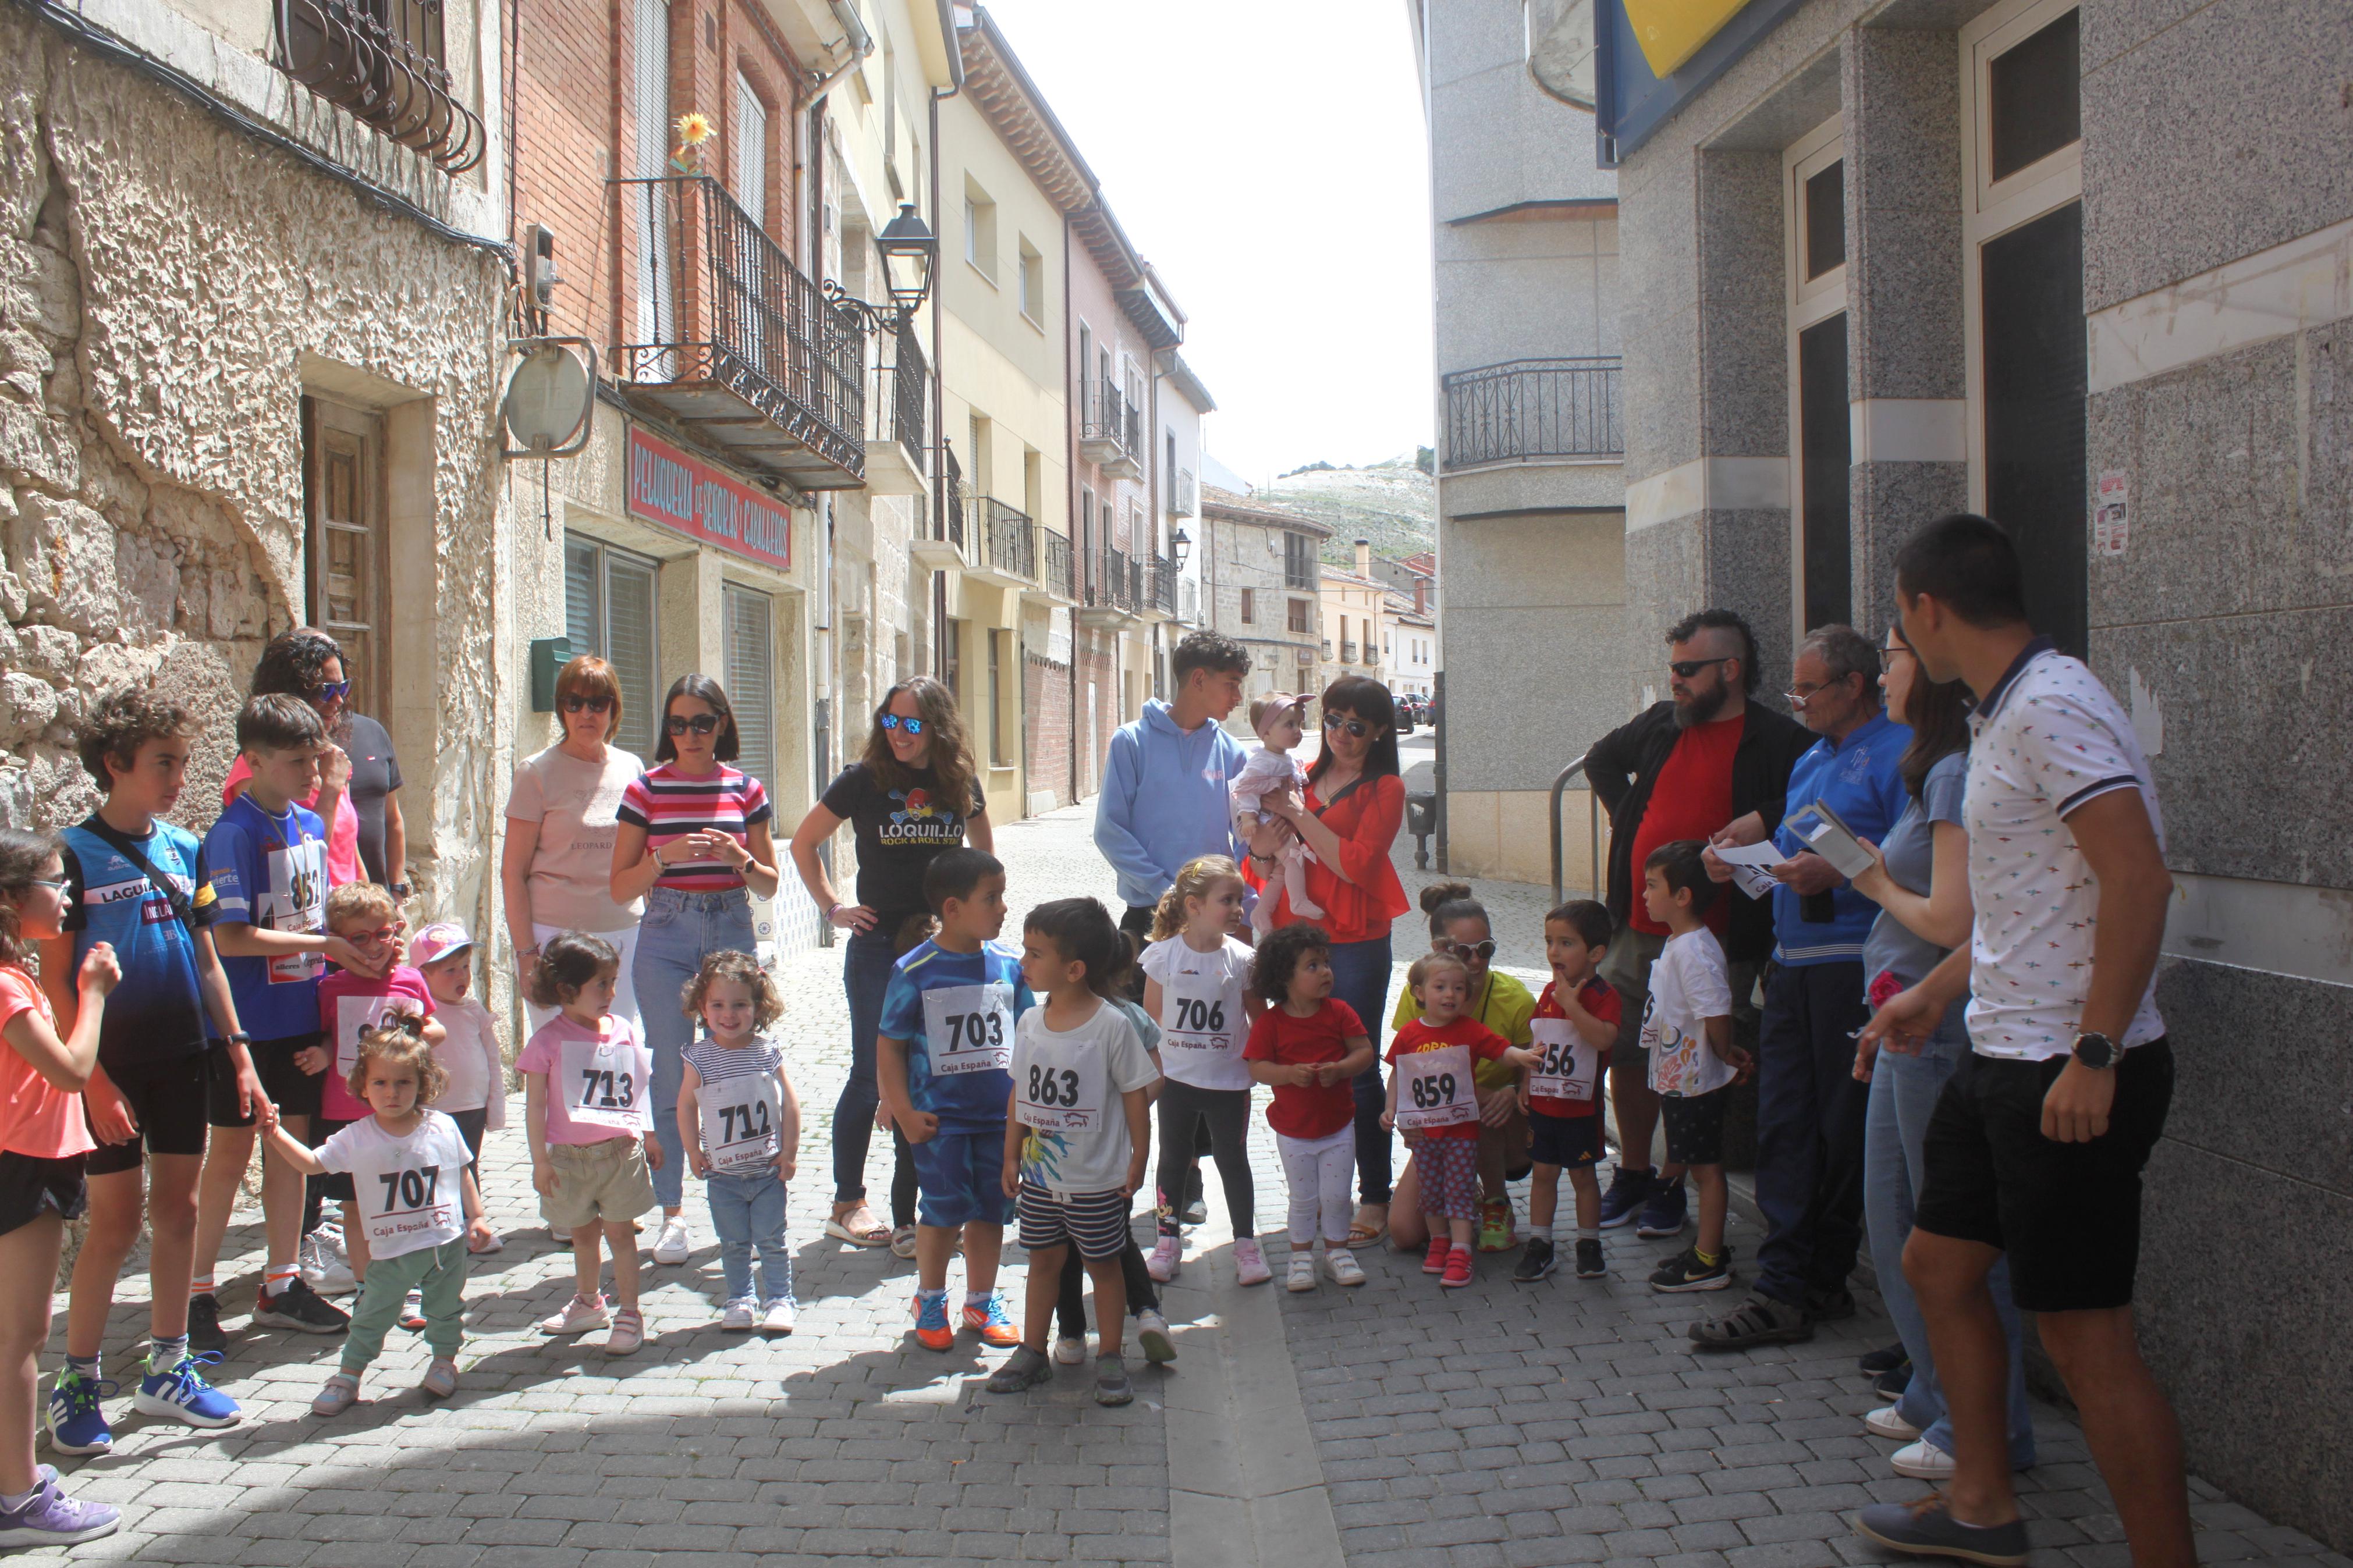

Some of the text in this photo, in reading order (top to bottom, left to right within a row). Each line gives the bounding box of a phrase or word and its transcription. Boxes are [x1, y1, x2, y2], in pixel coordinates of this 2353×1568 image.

[634, 442, 787, 559] PELUQUERIA DE SEÑORAS Y CABALLEROS
[879, 824, 962, 838] LOQUILLO
[571, 842, 612, 850] LEOPARD
[881, 837, 908, 845] ROCK
[1755, 879, 1773, 893] Caja
[1176, 998, 1225, 1032] 706
[945, 1012, 1003, 1052] 703
[1168, 1039, 1206, 1050] Caja España
[941, 1060, 992, 1073] Caja España
[583, 1069, 634, 1108] 713
[1029, 1064, 1079, 1107] 863
[1412, 1073, 1456, 1108] 859
[718, 1100, 772, 1144] 712
[1033, 1116, 1060, 1127] España
[1424, 1117, 1449, 1126] España
[718, 1149, 763, 1166] Caja España
[379, 1165, 439, 1212] 707
[373, 1221, 429, 1238] Caja España
